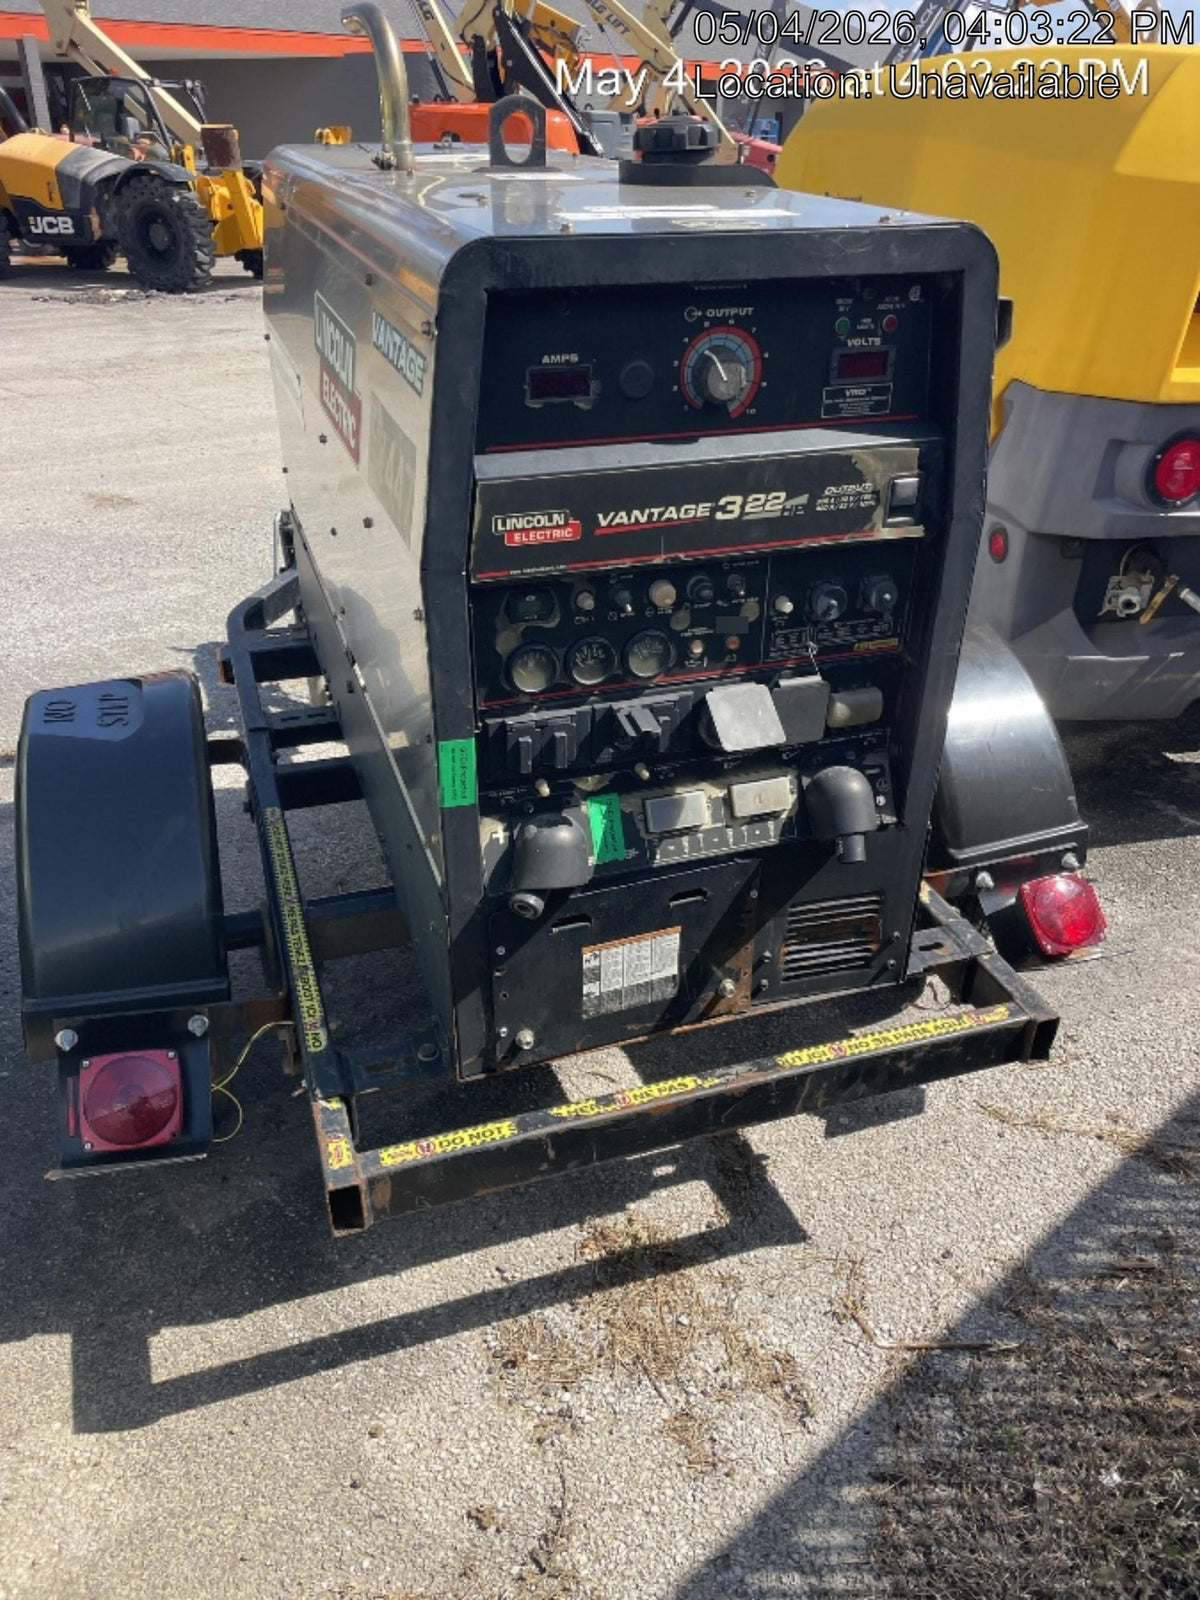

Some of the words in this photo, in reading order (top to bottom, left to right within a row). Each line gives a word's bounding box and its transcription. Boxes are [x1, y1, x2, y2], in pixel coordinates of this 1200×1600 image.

[605, 10, 631, 36] LIFT
[28, 216, 75, 234] JCB
[705, 306, 754, 318] OUTPUT
[315, 303, 355, 396] LINCOLN
[846, 337, 882, 347] VOLTS
[372, 310, 425, 400] VANTAGE
[541, 353, 578, 364] AMPS
[823, 482, 873, 495] OUTPUT
[714, 492, 785, 519] 322
[496, 513, 564, 531] LINCOLN
[513, 527, 573, 543] ELECTRIC
[656, 1081, 690, 1095] PAS
[438, 1136, 464, 1149] DO
[467, 1126, 502, 1142] NOT
